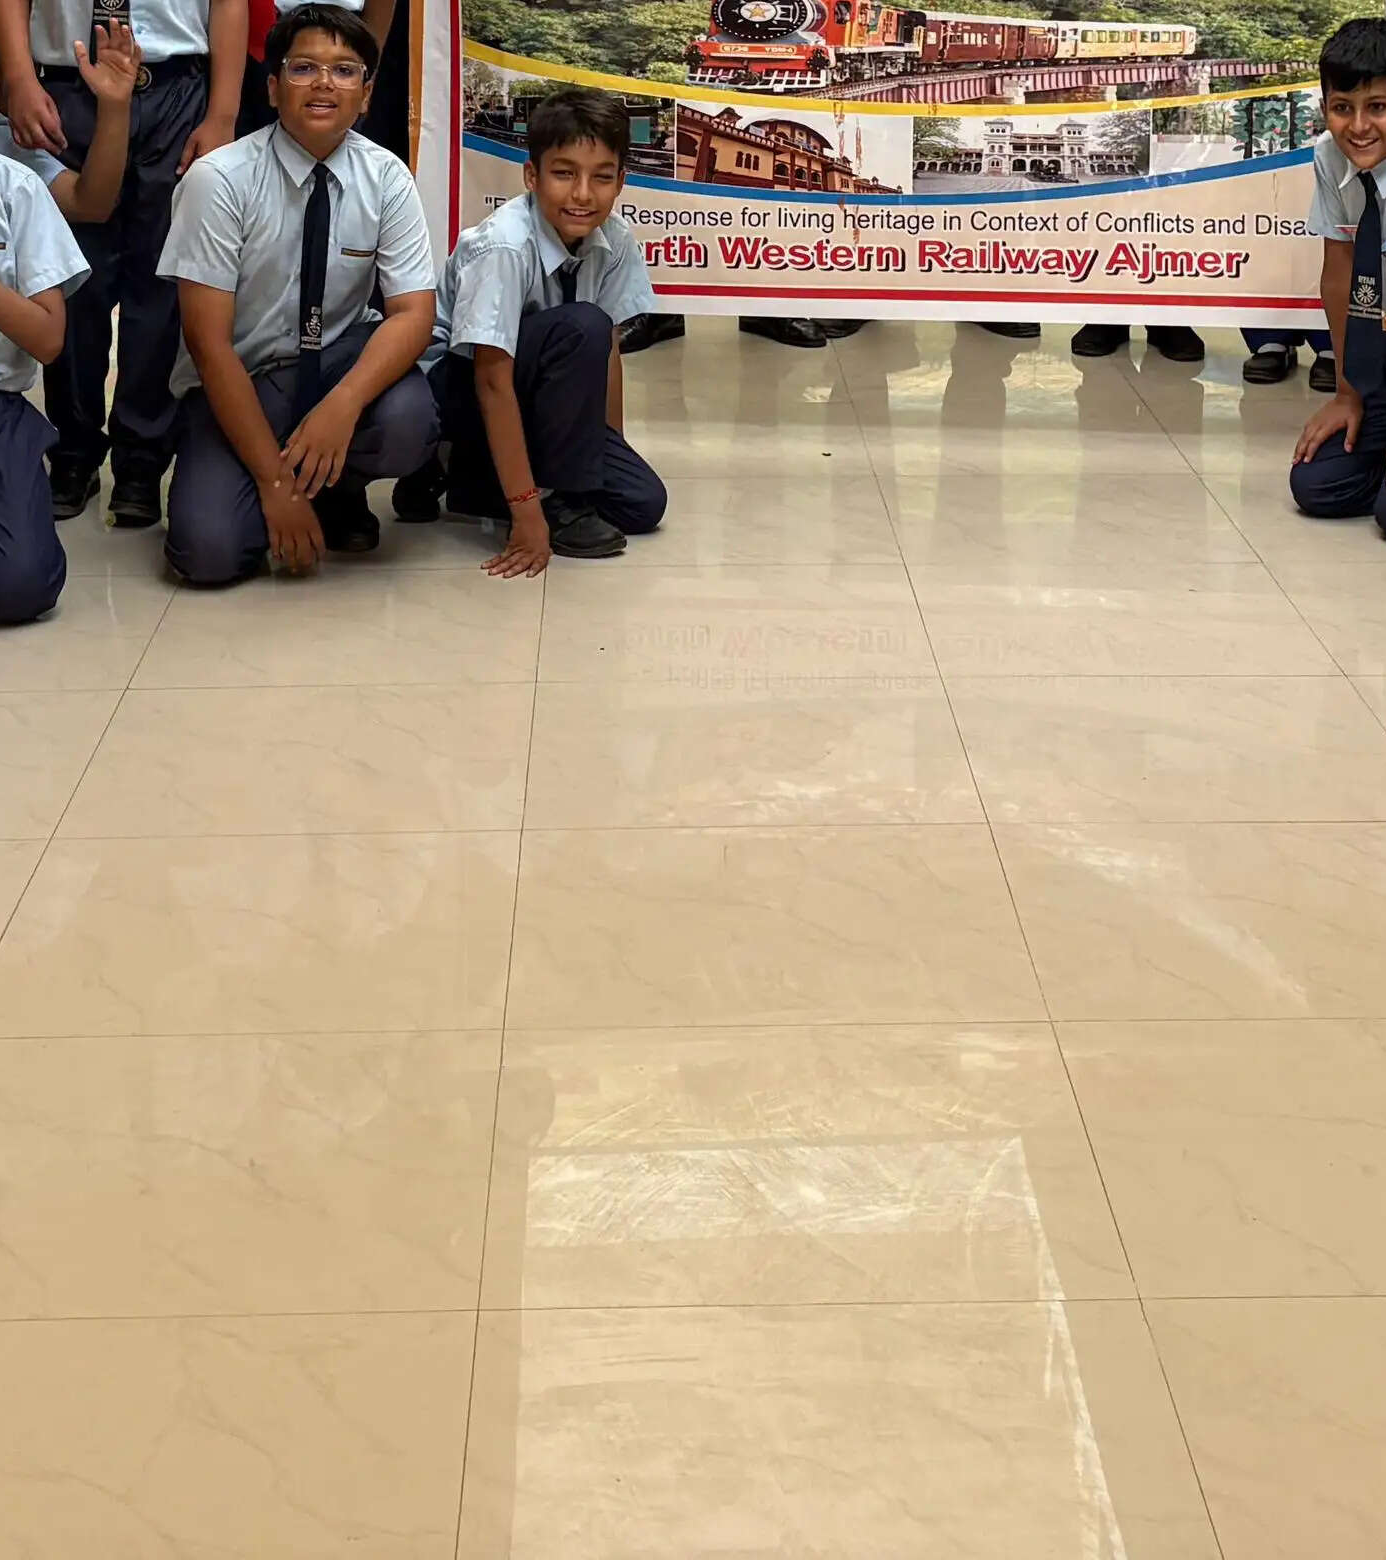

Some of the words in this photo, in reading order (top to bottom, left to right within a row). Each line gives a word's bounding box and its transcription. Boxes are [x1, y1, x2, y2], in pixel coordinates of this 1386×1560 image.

[621, 204, 732, 230] Response
[740, 207, 770, 228] for
[777, 207, 834, 233] living
[843, 209, 935, 236] heritage
[944, 211, 961, 231] in
[970, 211, 1061, 232] Context
[1066, 211, 1089, 232] of
[1095, 211, 1194, 234] Conflicts
[1203, 213, 1245, 235] and
[1255, 214, 1319, 236] Disa
[638, 235, 708, 269] rth
[717, 235, 906, 273] Western
[918, 240, 1095, 283] Railway
[1104, 241, 1250, 283] Ajmer
